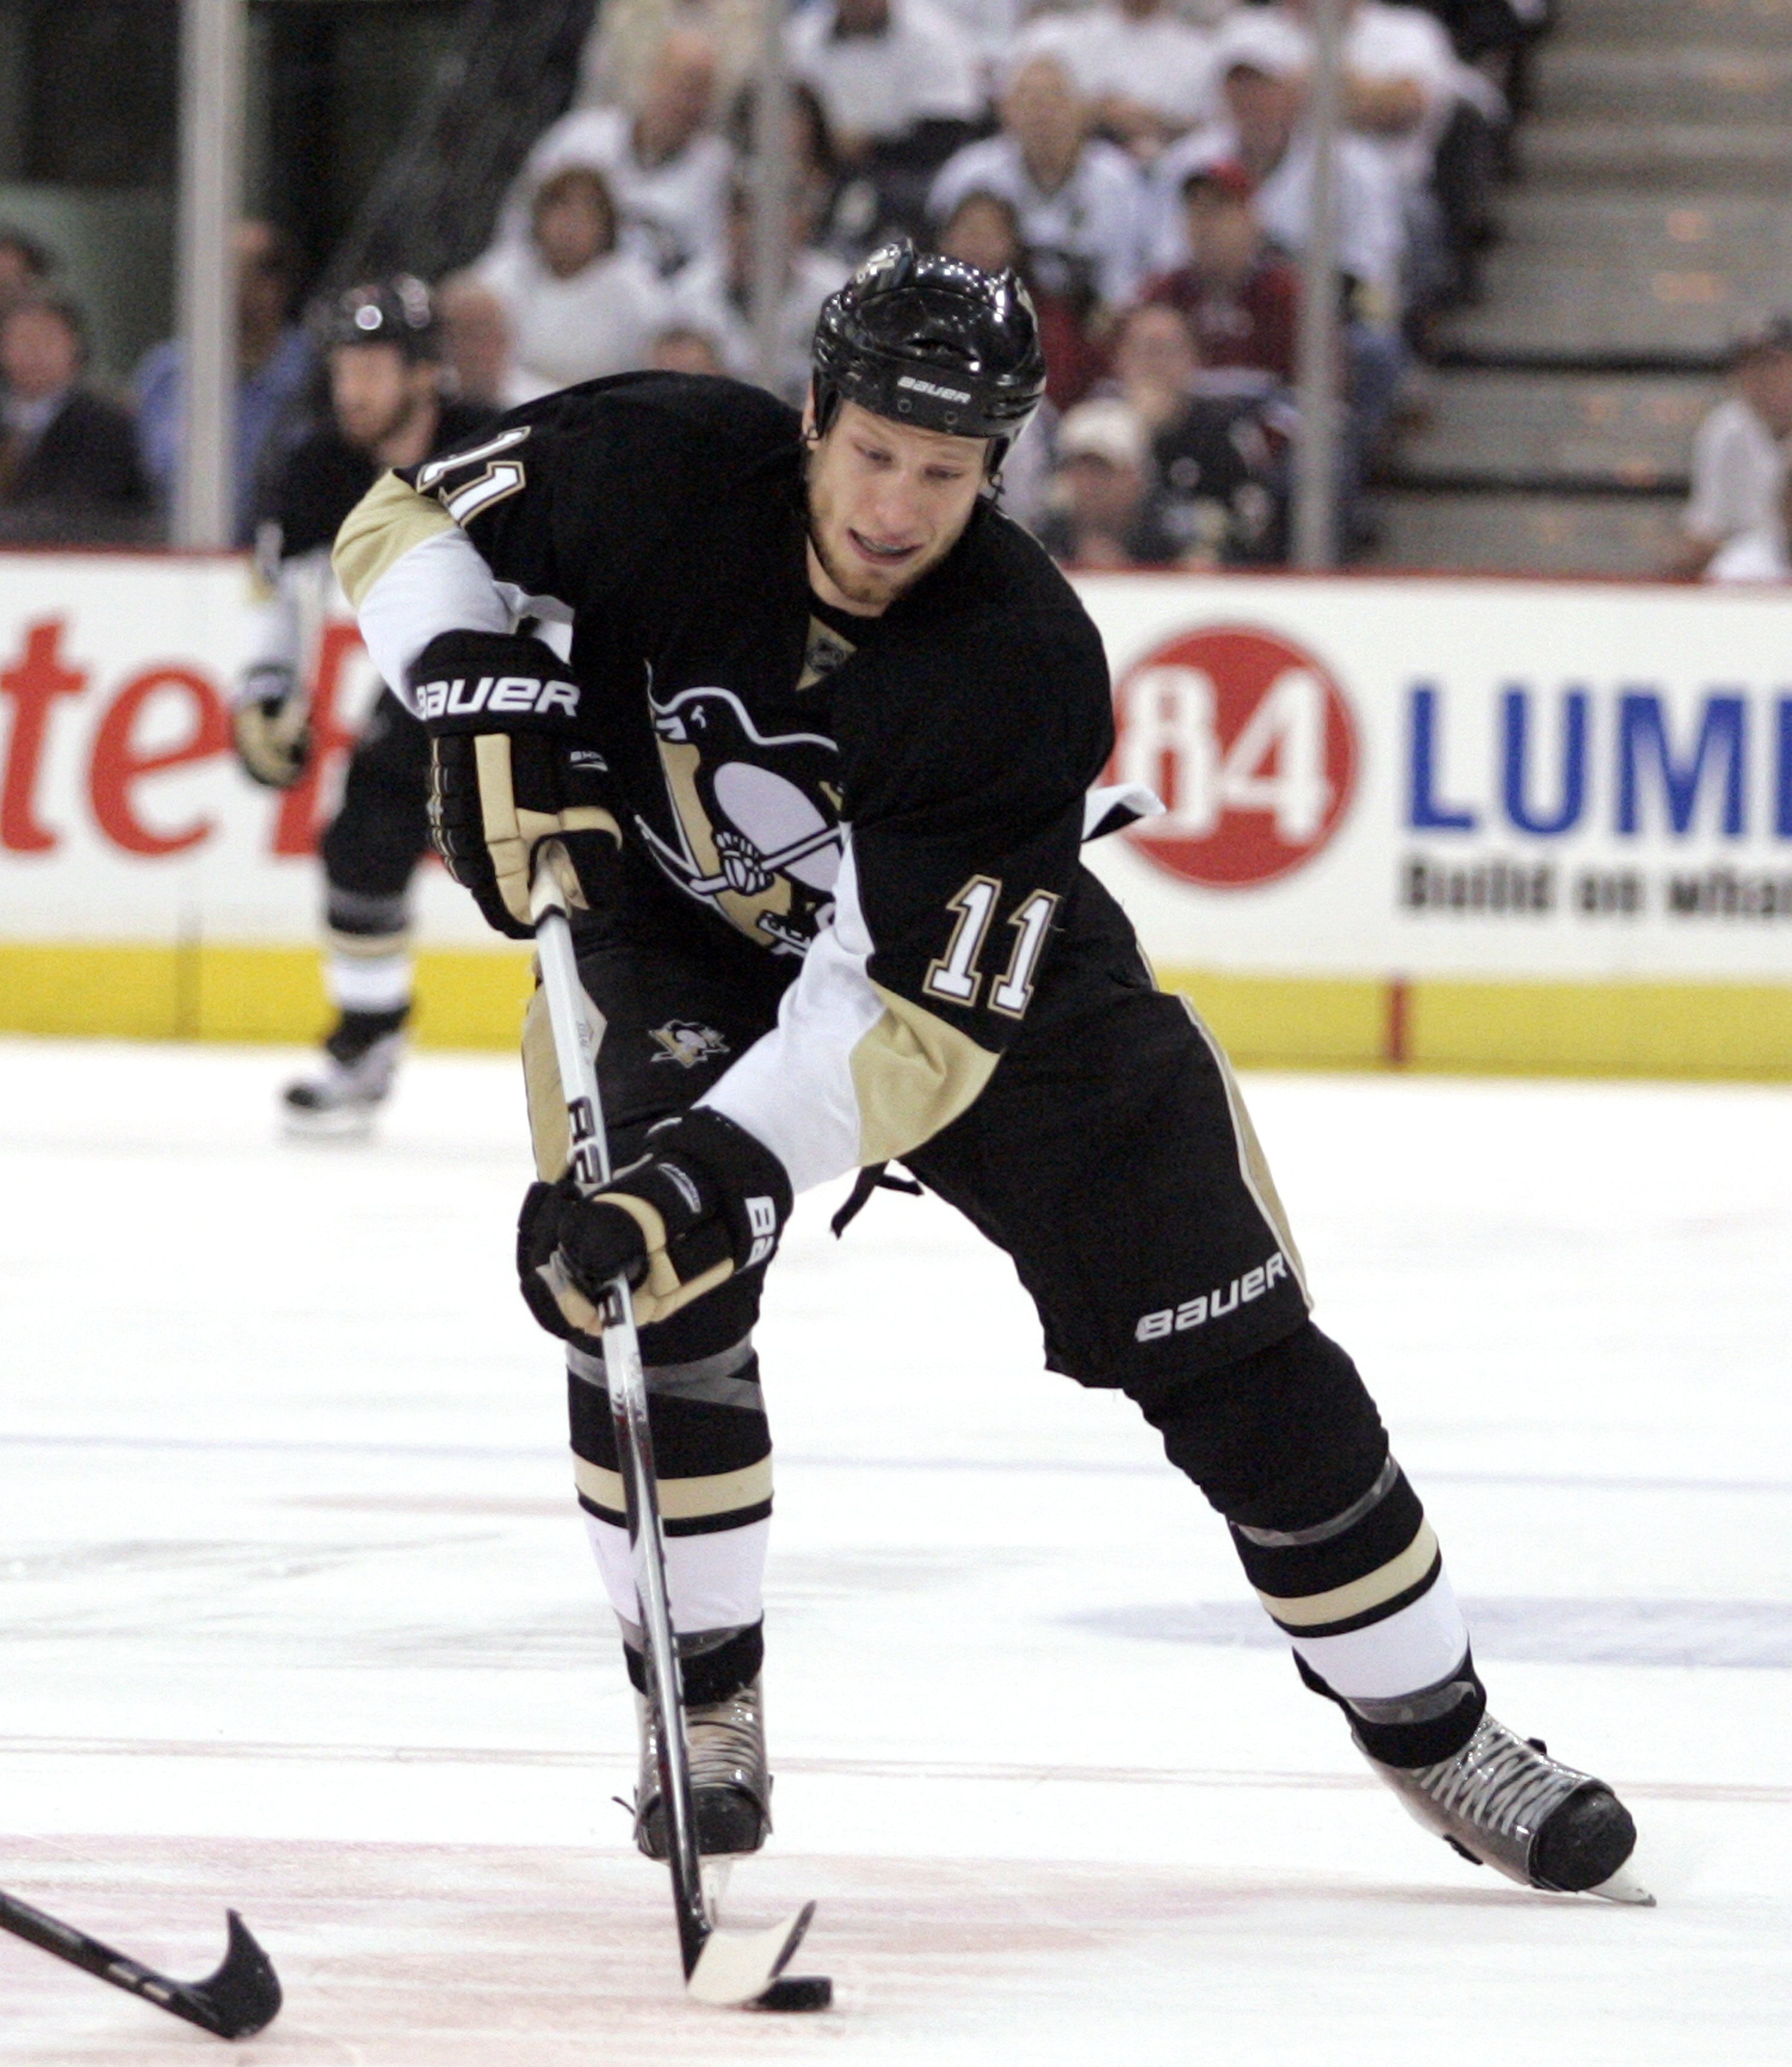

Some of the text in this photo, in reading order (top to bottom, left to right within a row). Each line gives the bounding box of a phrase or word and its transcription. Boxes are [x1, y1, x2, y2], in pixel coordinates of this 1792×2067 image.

[897, 375, 972, 404] BAUER
[1121, 663, 1336, 844] 84
[922, 874, 1061, 1020] 11
[1135, 1251, 1287, 1343] BAUER
